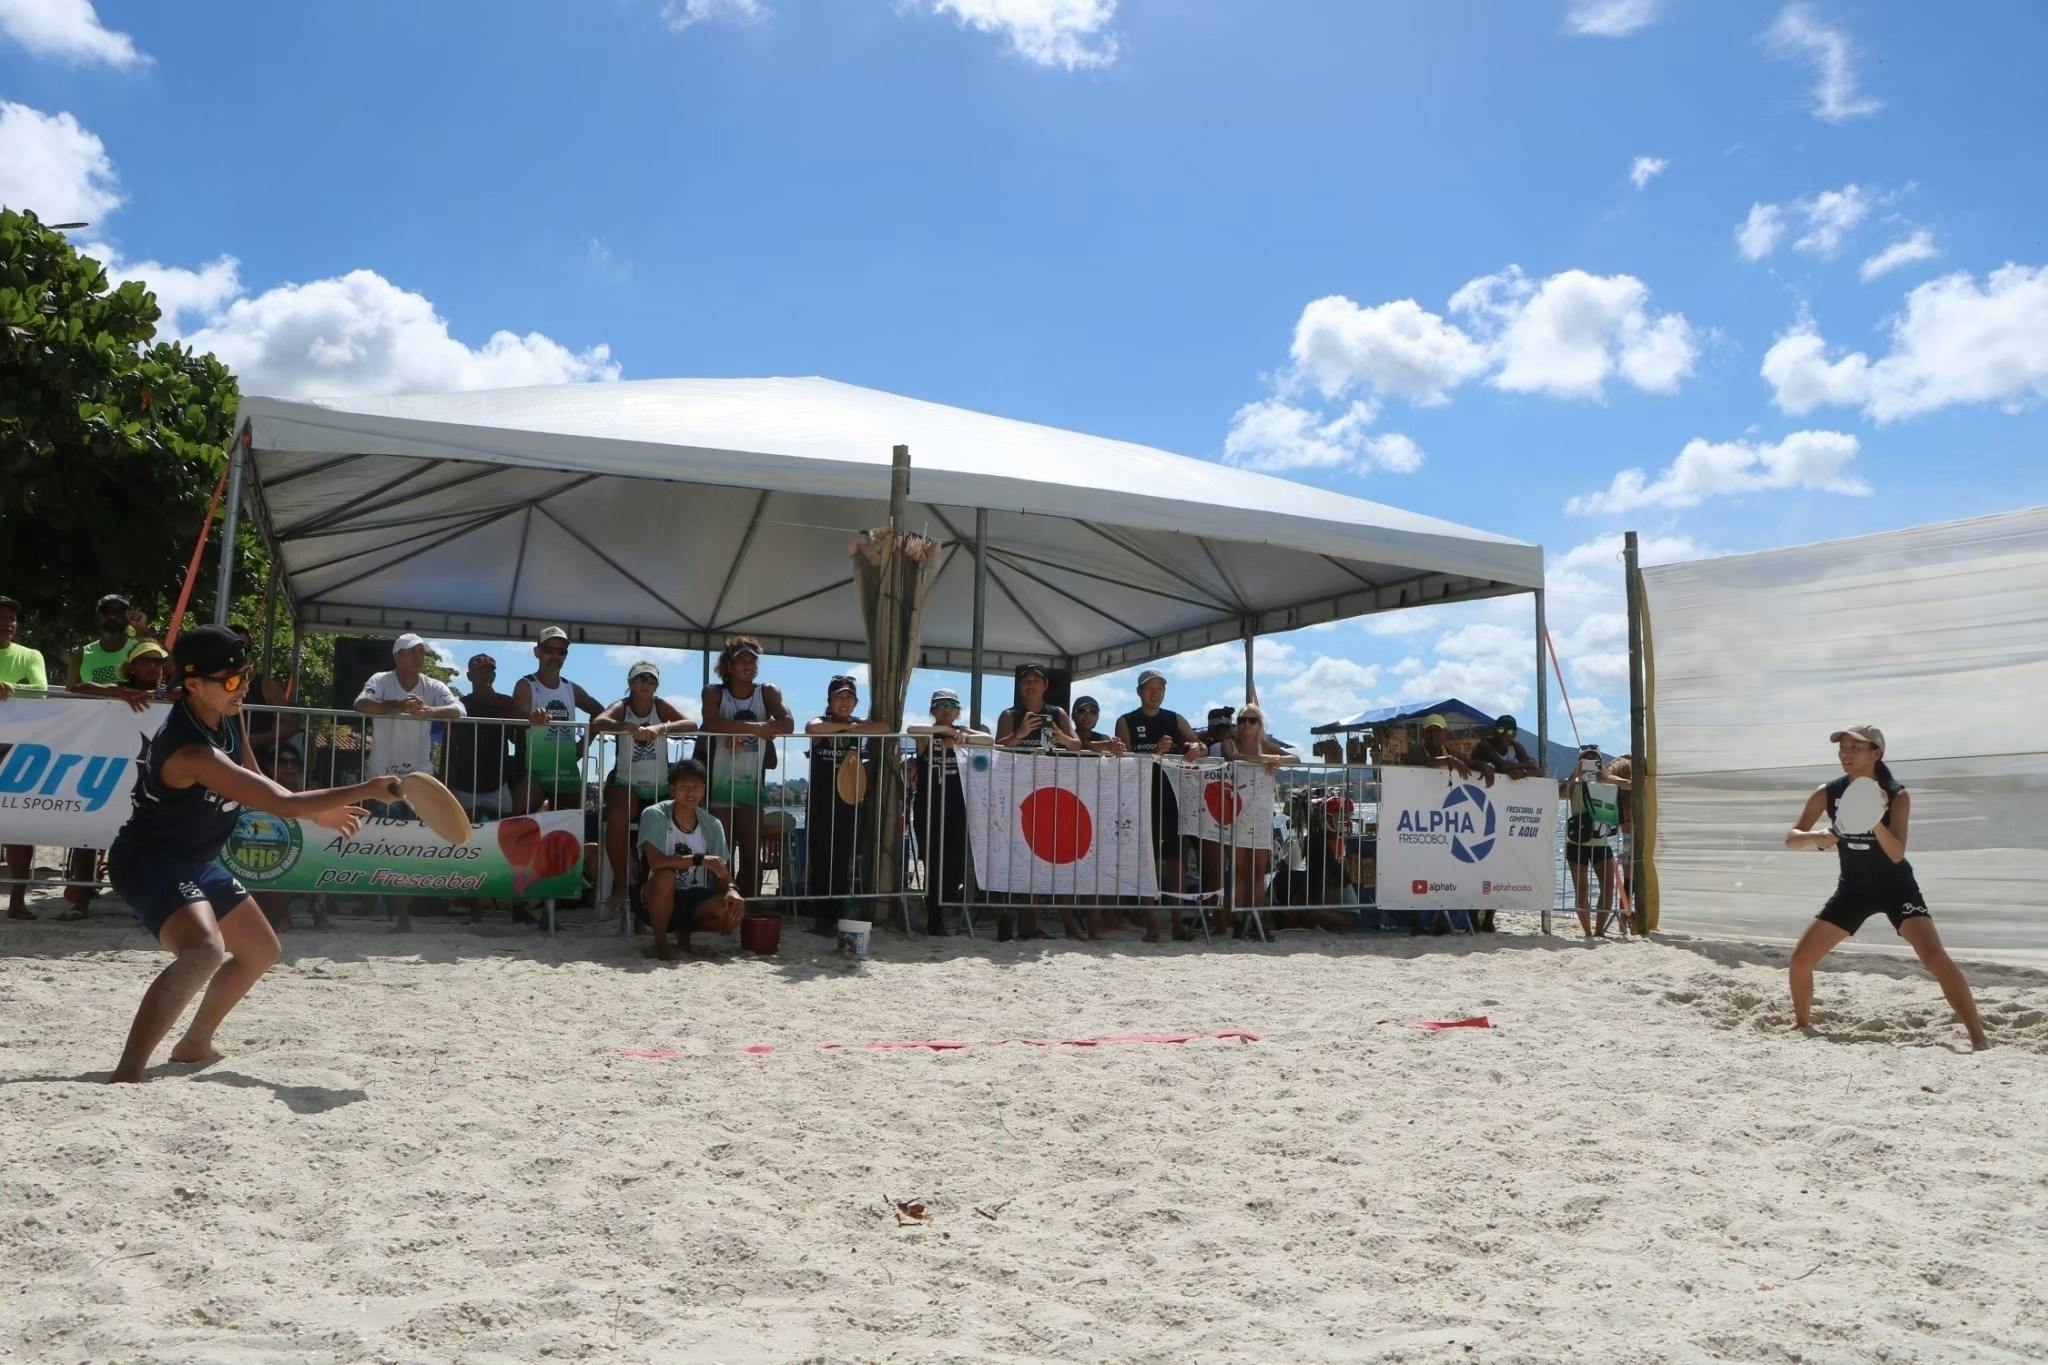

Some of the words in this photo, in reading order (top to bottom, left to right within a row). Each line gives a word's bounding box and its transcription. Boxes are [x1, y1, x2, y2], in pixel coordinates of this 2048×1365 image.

[0, 743, 130, 812] Dry
[0, 797, 18, 808] LL
[22, 797, 82, 812] SPORTS
[1506, 806, 1534, 814] FRESCOBOL
[1397, 809, 1475, 834] ALPHA
[1508, 823, 1516, 837] É
[1518, 826, 1539, 838] AQUI
[1398, 833, 1449, 845] FRESCOBOL
[323, 836, 482, 860] Apaixonados
[316, 868, 366, 887] por
[370, 868, 488, 890] Frescobol
[1429, 882, 1457, 892] alphatv
